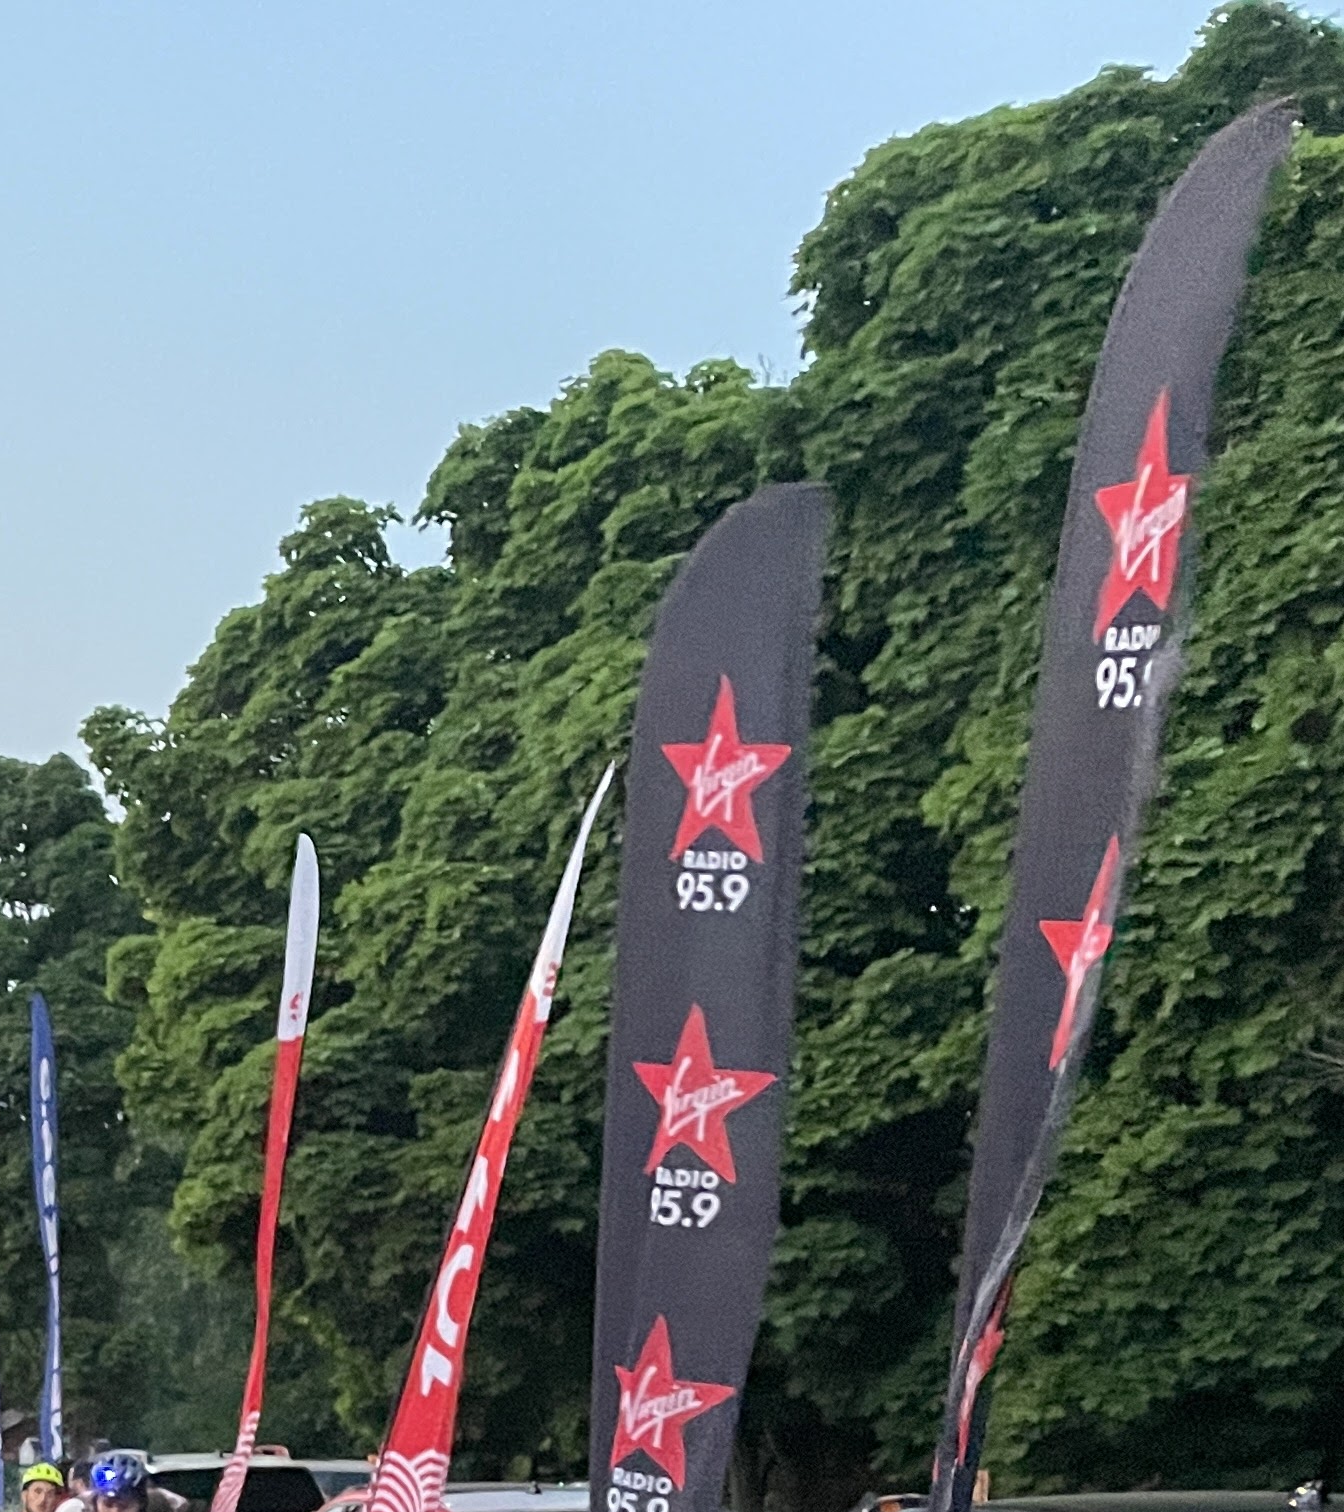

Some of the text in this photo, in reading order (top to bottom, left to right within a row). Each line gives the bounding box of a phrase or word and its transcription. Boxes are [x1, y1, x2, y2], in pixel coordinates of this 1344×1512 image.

[692, 733, 766, 823] Virgin
[683, 850, 748, 870] RADIO
[676, 872, 750, 912] 95.9
[665, 1056, 745, 1142] Virgin
[621, 1365, 703, 1449] Virgin
[613, 1467, 673, 1495] RADIO
